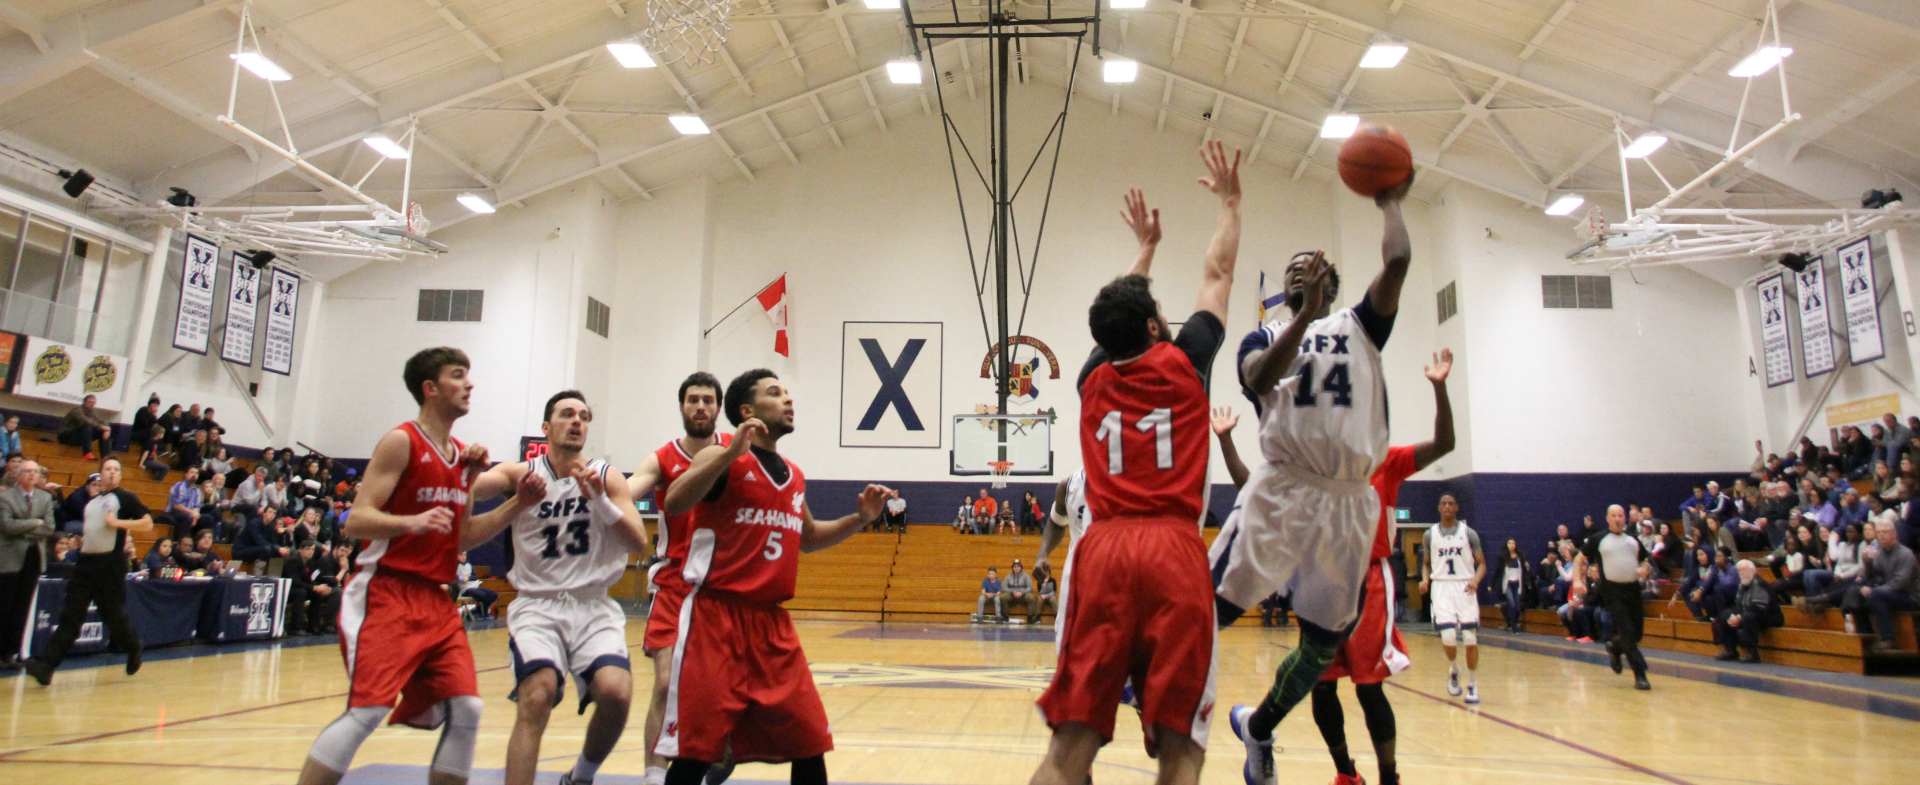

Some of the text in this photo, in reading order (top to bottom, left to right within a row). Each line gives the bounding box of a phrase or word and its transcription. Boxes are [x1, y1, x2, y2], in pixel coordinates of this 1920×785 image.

[188, 243, 215, 293] X
[232, 260, 258, 307] X
[1843, 247, 1869, 299] X
[272, 275, 296, 320] X
[1762, 282, 1782, 328] X
[1801, 266, 1822, 315] X
[1297, 334, 1349, 354] tFX
[1903, 311, 1916, 336] B
[1047, 351, 1058, 371] VERA
[1749, 356, 1757, 377] A
[856, 338, 927, 431] X
[1294, 361, 1353, 407] 14
[525, 442, 549, 462] 20
[1095, 407, 1174, 475] 11
[538, 495, 590, 519] StFX
[541, 518, 591, 560] 13
[763, 530, 783, 561] 5
[1438, 546, 1463, 557] StFX
[1445, 558, 1456, 575] 1
[247, 583, 275, 634] X
